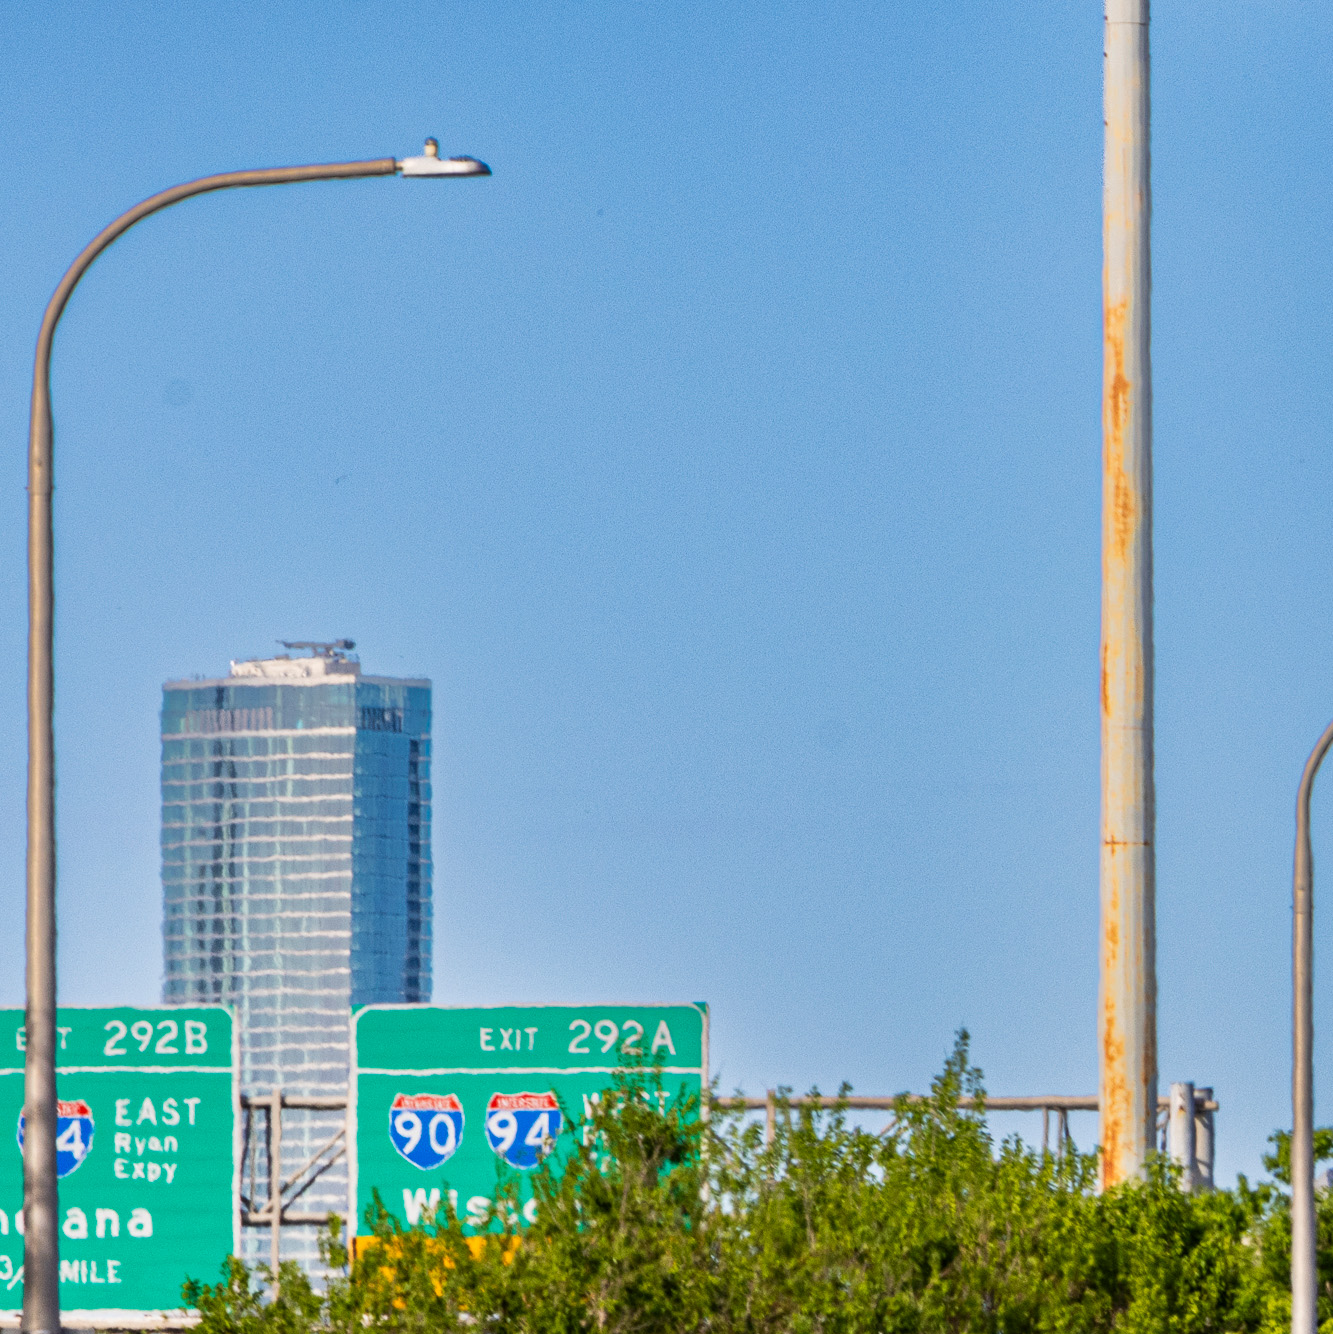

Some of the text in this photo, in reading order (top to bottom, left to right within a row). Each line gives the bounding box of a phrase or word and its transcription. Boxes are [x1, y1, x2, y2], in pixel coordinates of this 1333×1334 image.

[16, 1019, 208, 1056] ET 292B
[480, 1019, 676, 1055] EXIT 292A
[115, 1097, 201, 1126] EAST
[114, 1132, 178, 1156] Ryan
[394, 1111, 456, 1155] 90
[488, 1109, 551, 1155] 94
[114, 1158, 177, 1184] Expy
[60, 1259, 122, 1284] MILE
